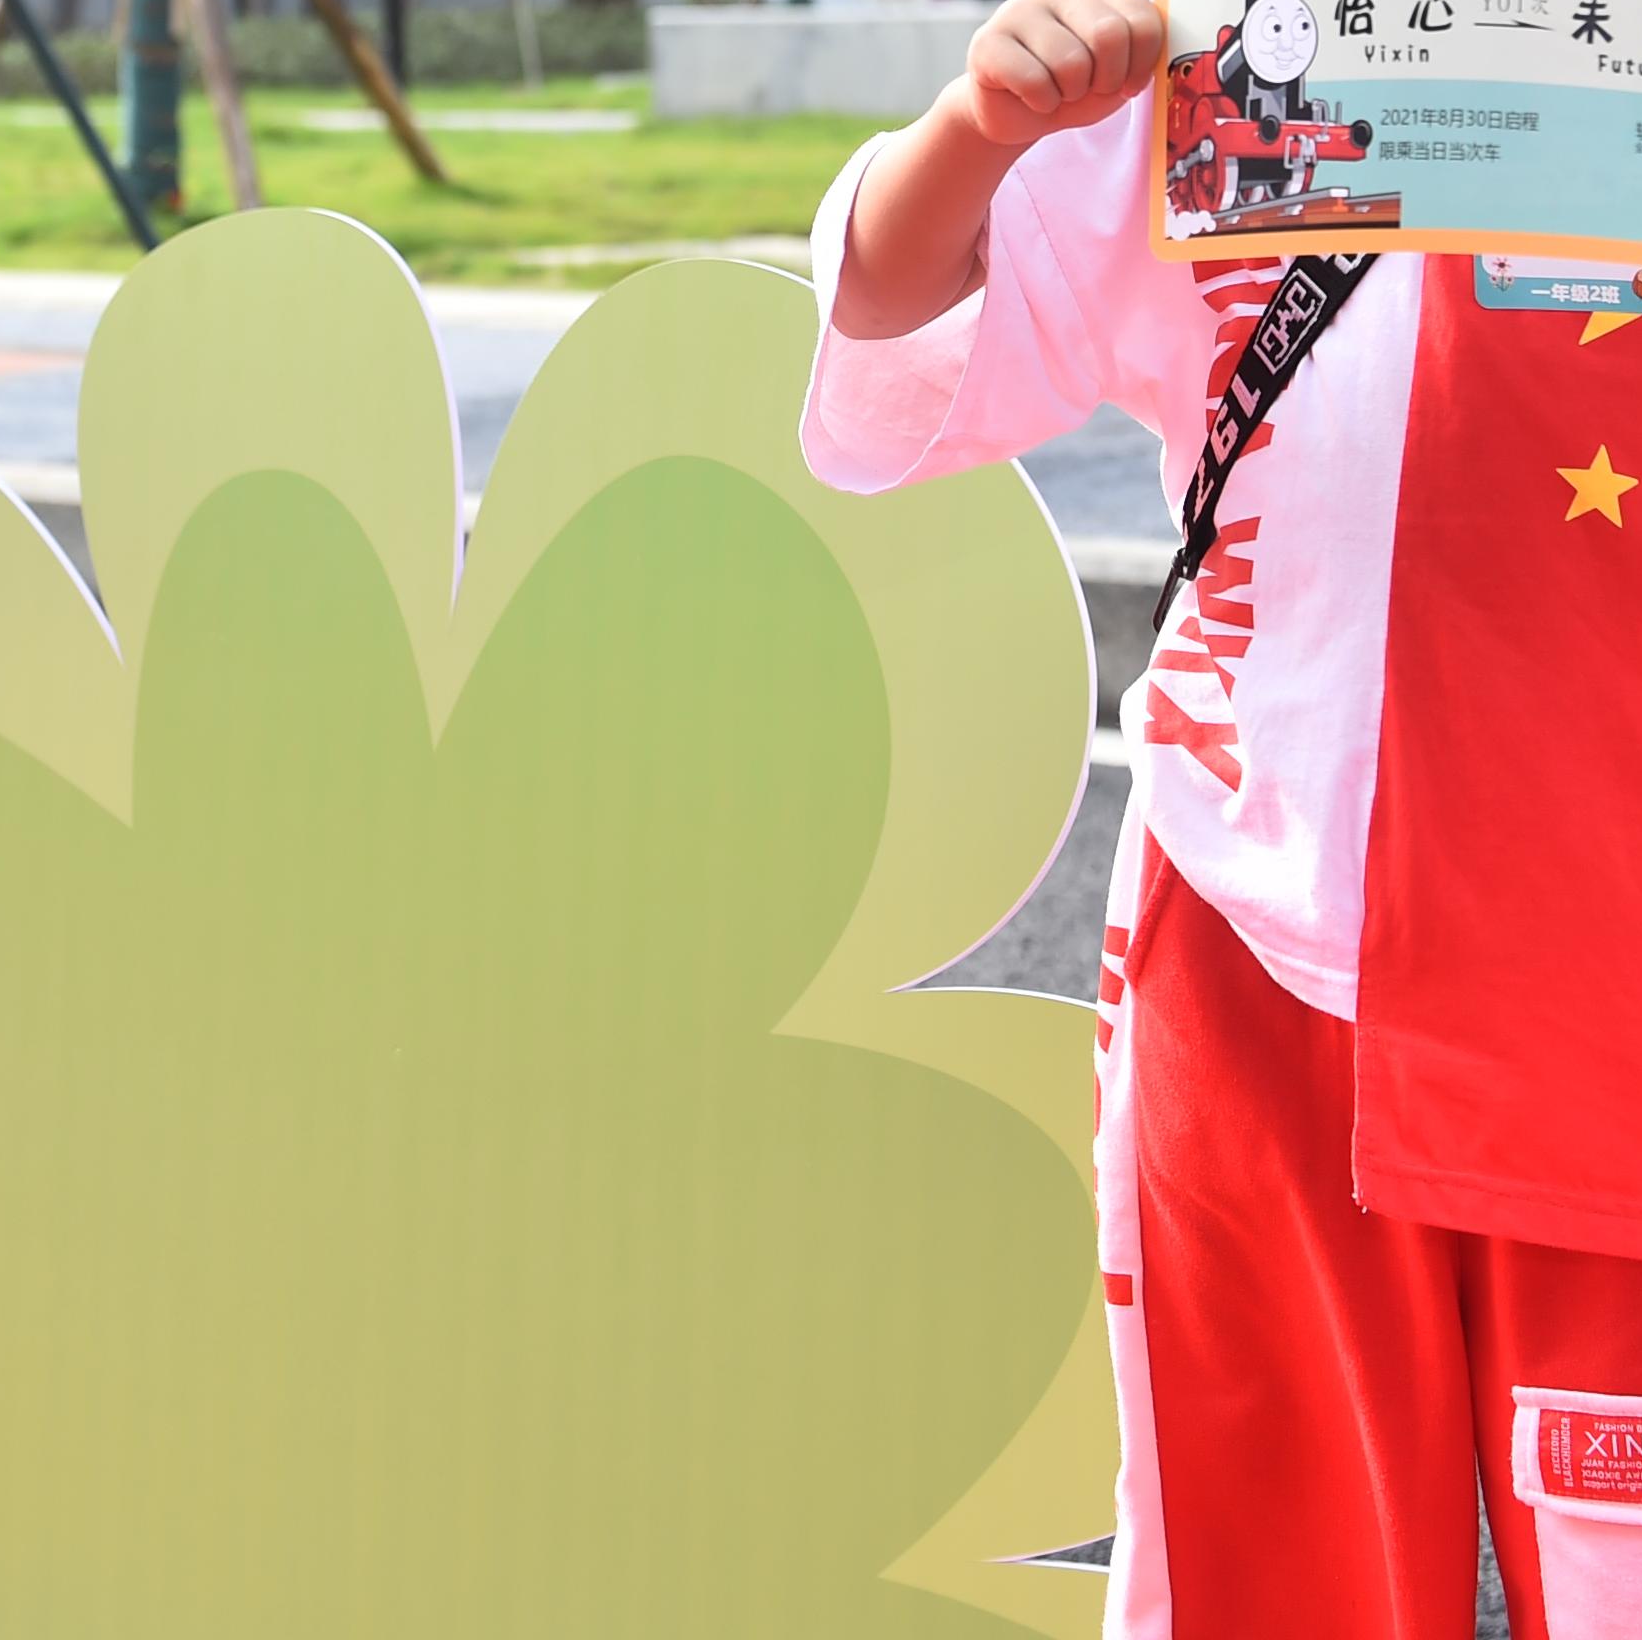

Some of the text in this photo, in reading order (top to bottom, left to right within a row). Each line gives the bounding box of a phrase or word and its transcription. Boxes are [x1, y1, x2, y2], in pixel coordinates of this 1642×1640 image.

[1364, 45, 1431, 63] Yixin
[1380, 108, 1540, 132] 2021年8月30日启程
[1379, 141, 1501, 162] 限乘当日当次车
[1530, 283, 1621, 304] 一年级2班
[1594, 1422, 1634, 1433] FASHION
